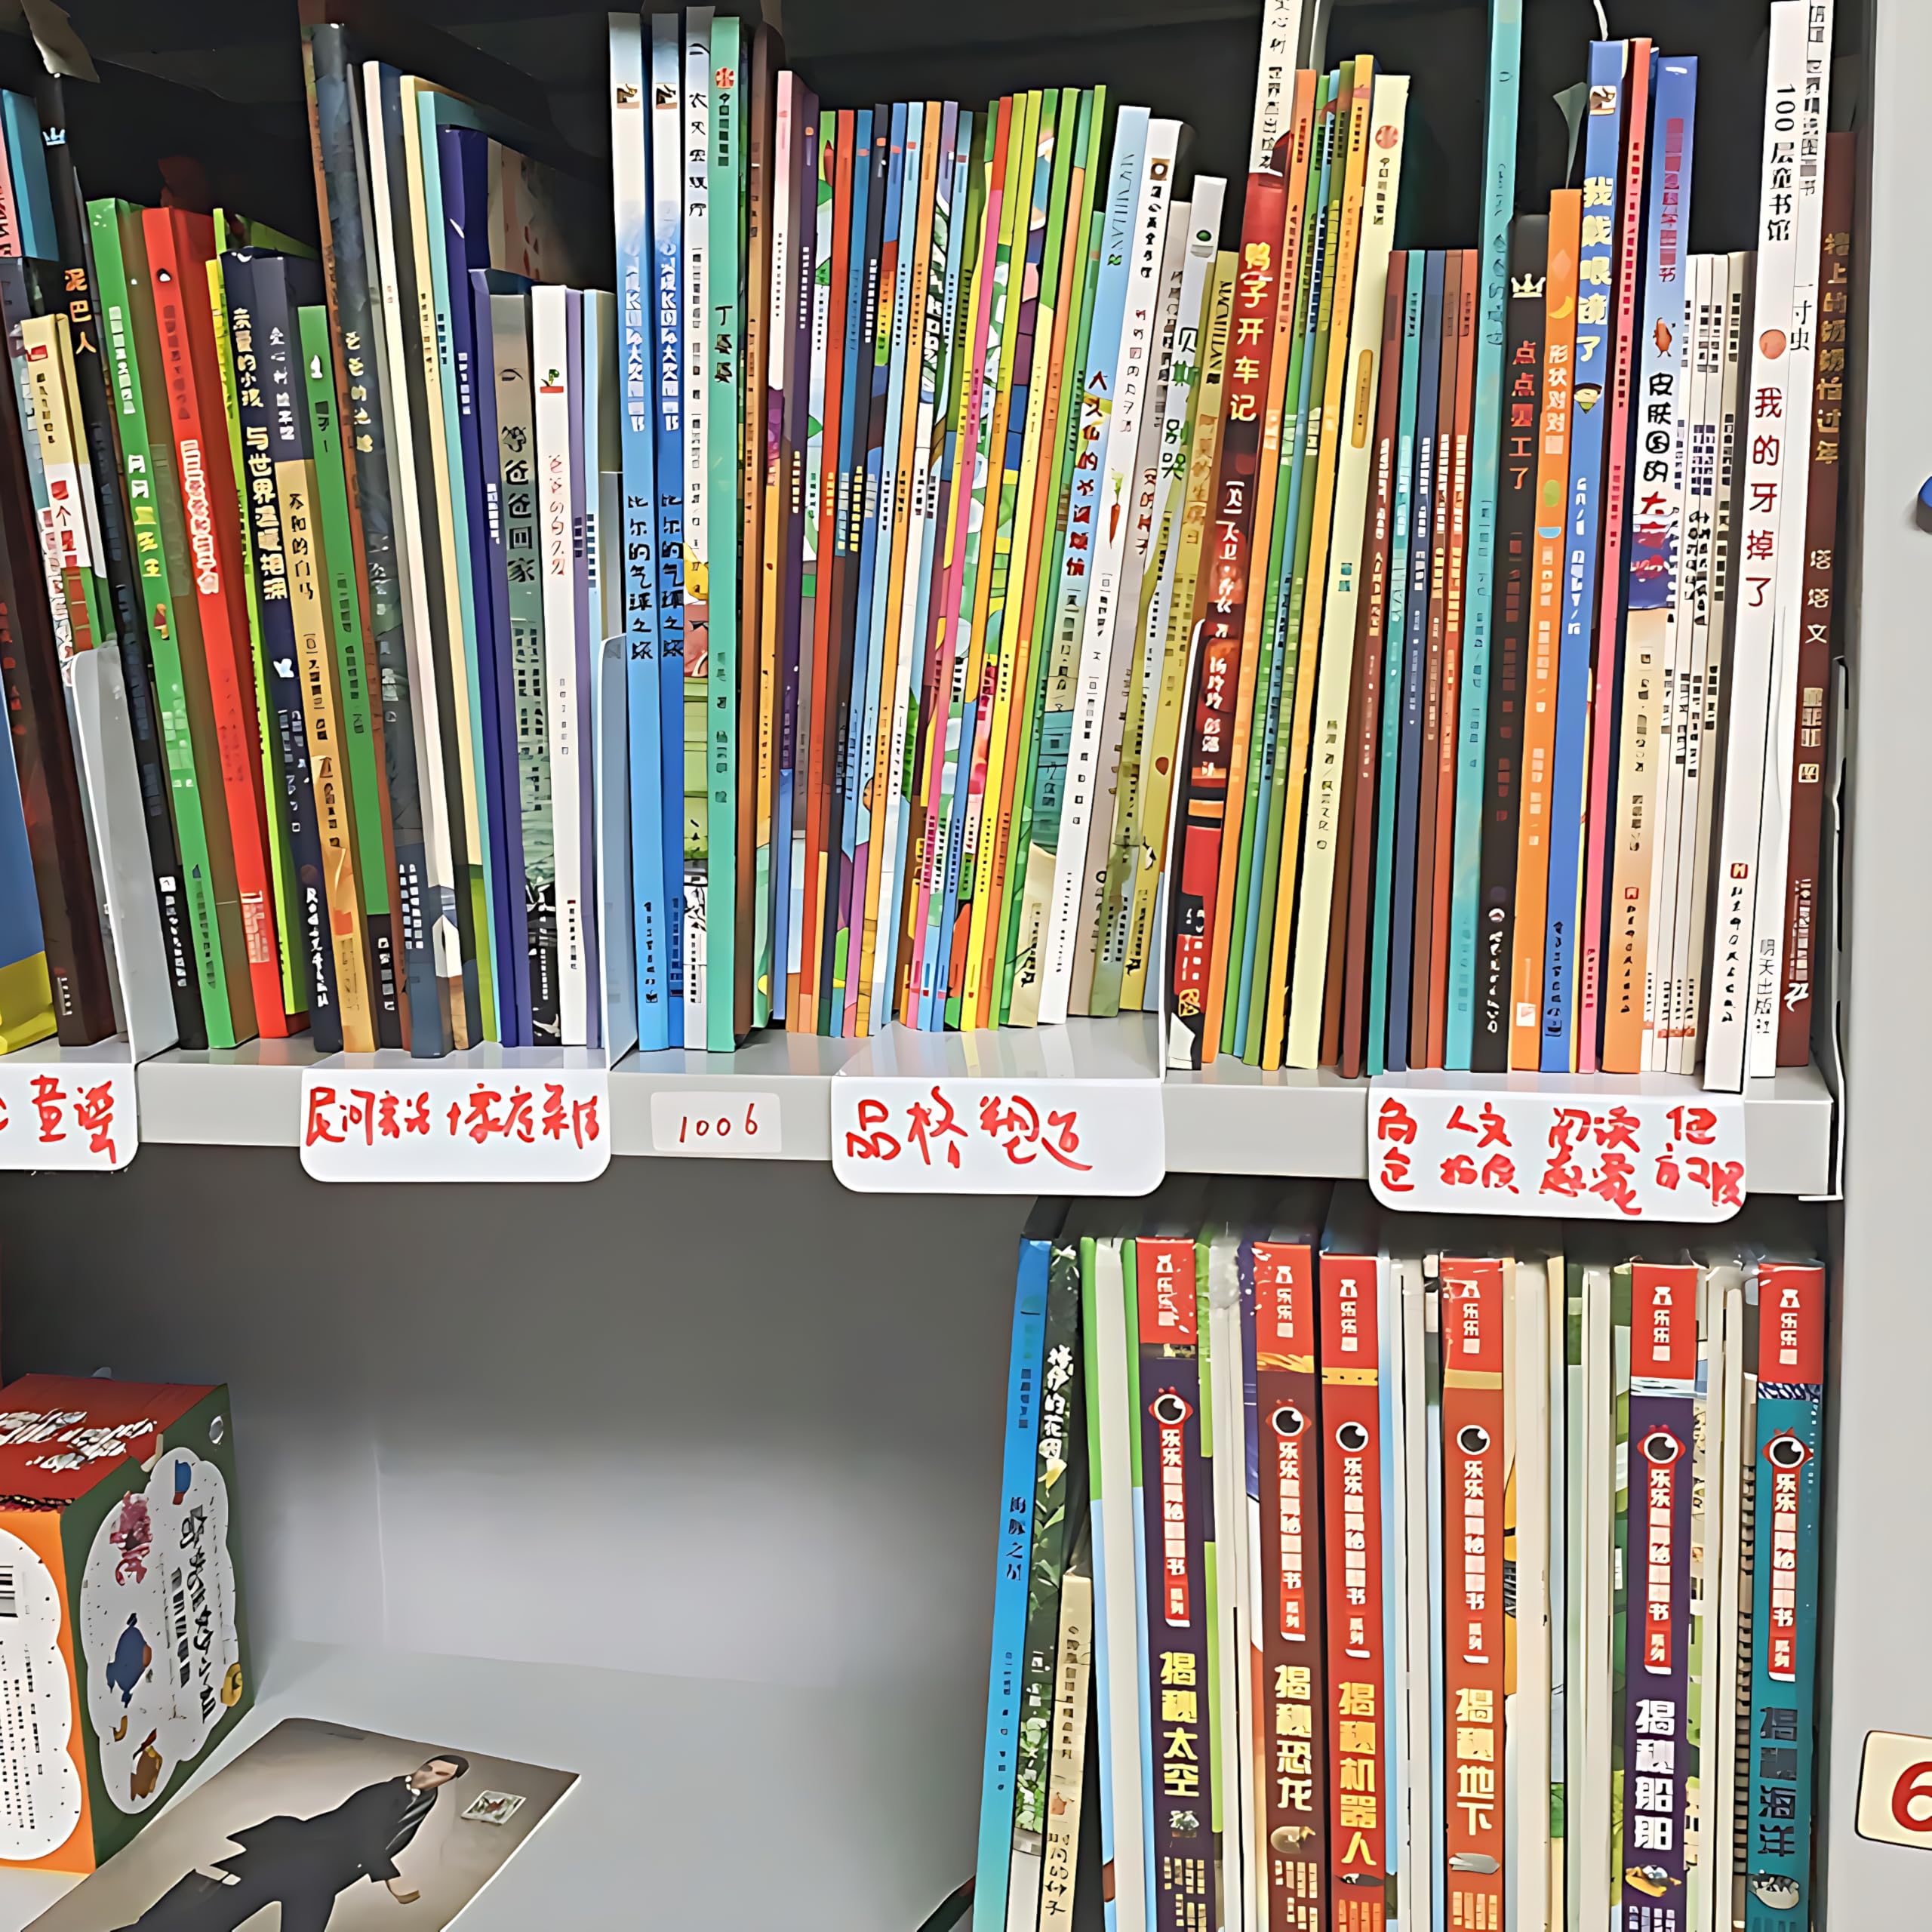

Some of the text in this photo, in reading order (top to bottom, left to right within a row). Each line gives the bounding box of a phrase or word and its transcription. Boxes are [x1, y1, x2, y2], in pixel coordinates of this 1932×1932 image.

[64, 267, 97, 355] 泥巴人
[1229, 242, 1272, 422] 鸭子开车记
[1544, 344, 1568, 454] 形状对对
[1746, 386, 1783, 608] 我的牙掉了
[679, 1103, 758, 1143] 1006
[1159, 1651, 1200, 1798] 揭秘太空
